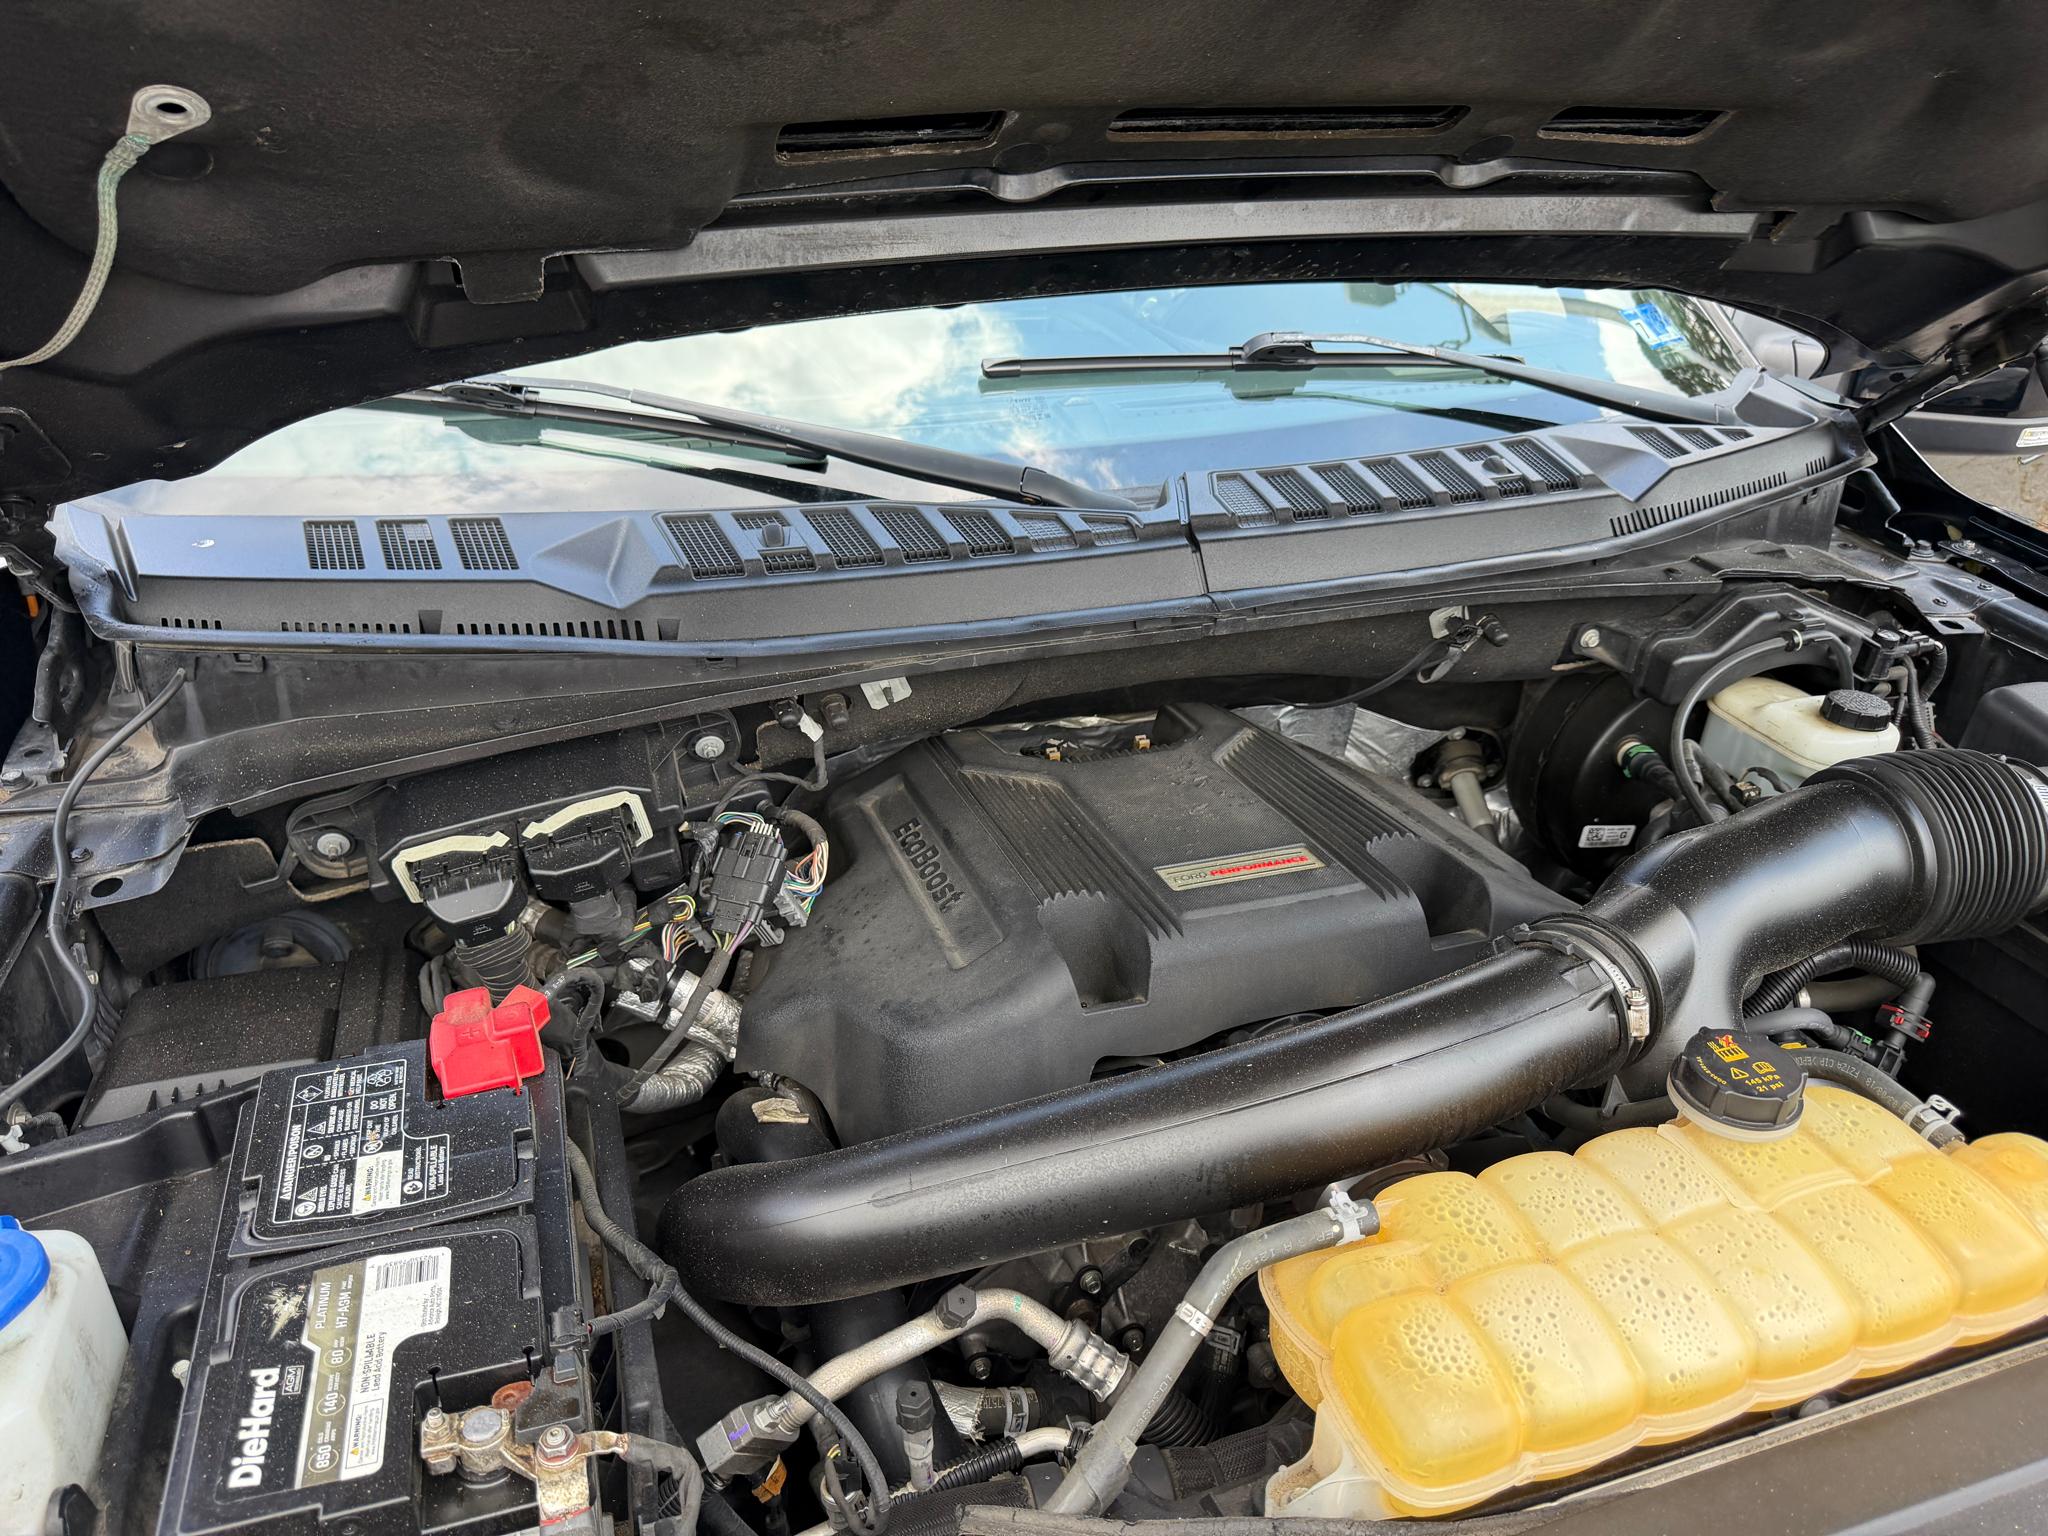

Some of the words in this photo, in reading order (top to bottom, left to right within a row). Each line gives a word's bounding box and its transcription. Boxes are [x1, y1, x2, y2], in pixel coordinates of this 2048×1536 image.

[892, 817, 965, 912] EcoBoost
[1172, 871, 1208, 884] FORD
[1209, 855, 1309, 877] PERFORMANCE
[1756, 1084, 1769, 1093] 21
[370, 1100, 379, 1110] DO
[379, 1098, 388, 1110] NOT
[282, 1123, 302, 1194] DANGER/POISON
[429, 1144, 438, 1190] NON-SPILLABLE
[315, 1282, 331, 1329] PLATINUM
[331, 1349, 345, 1364] 80
[375, 1331, 387, 1358] Battery
[360, 1333, 376, 1394] NON-SPILLABLE
[373, 1358, 384, 1373] Acid
[284, 1367, 297, 1392] AGM
[370, 1373, 381, 1391] Lead
[323, 1392, 338, 1413] 140
[227, 1366, 280, 1488] DieHard
[315, 1444, 331, 1468] 850
